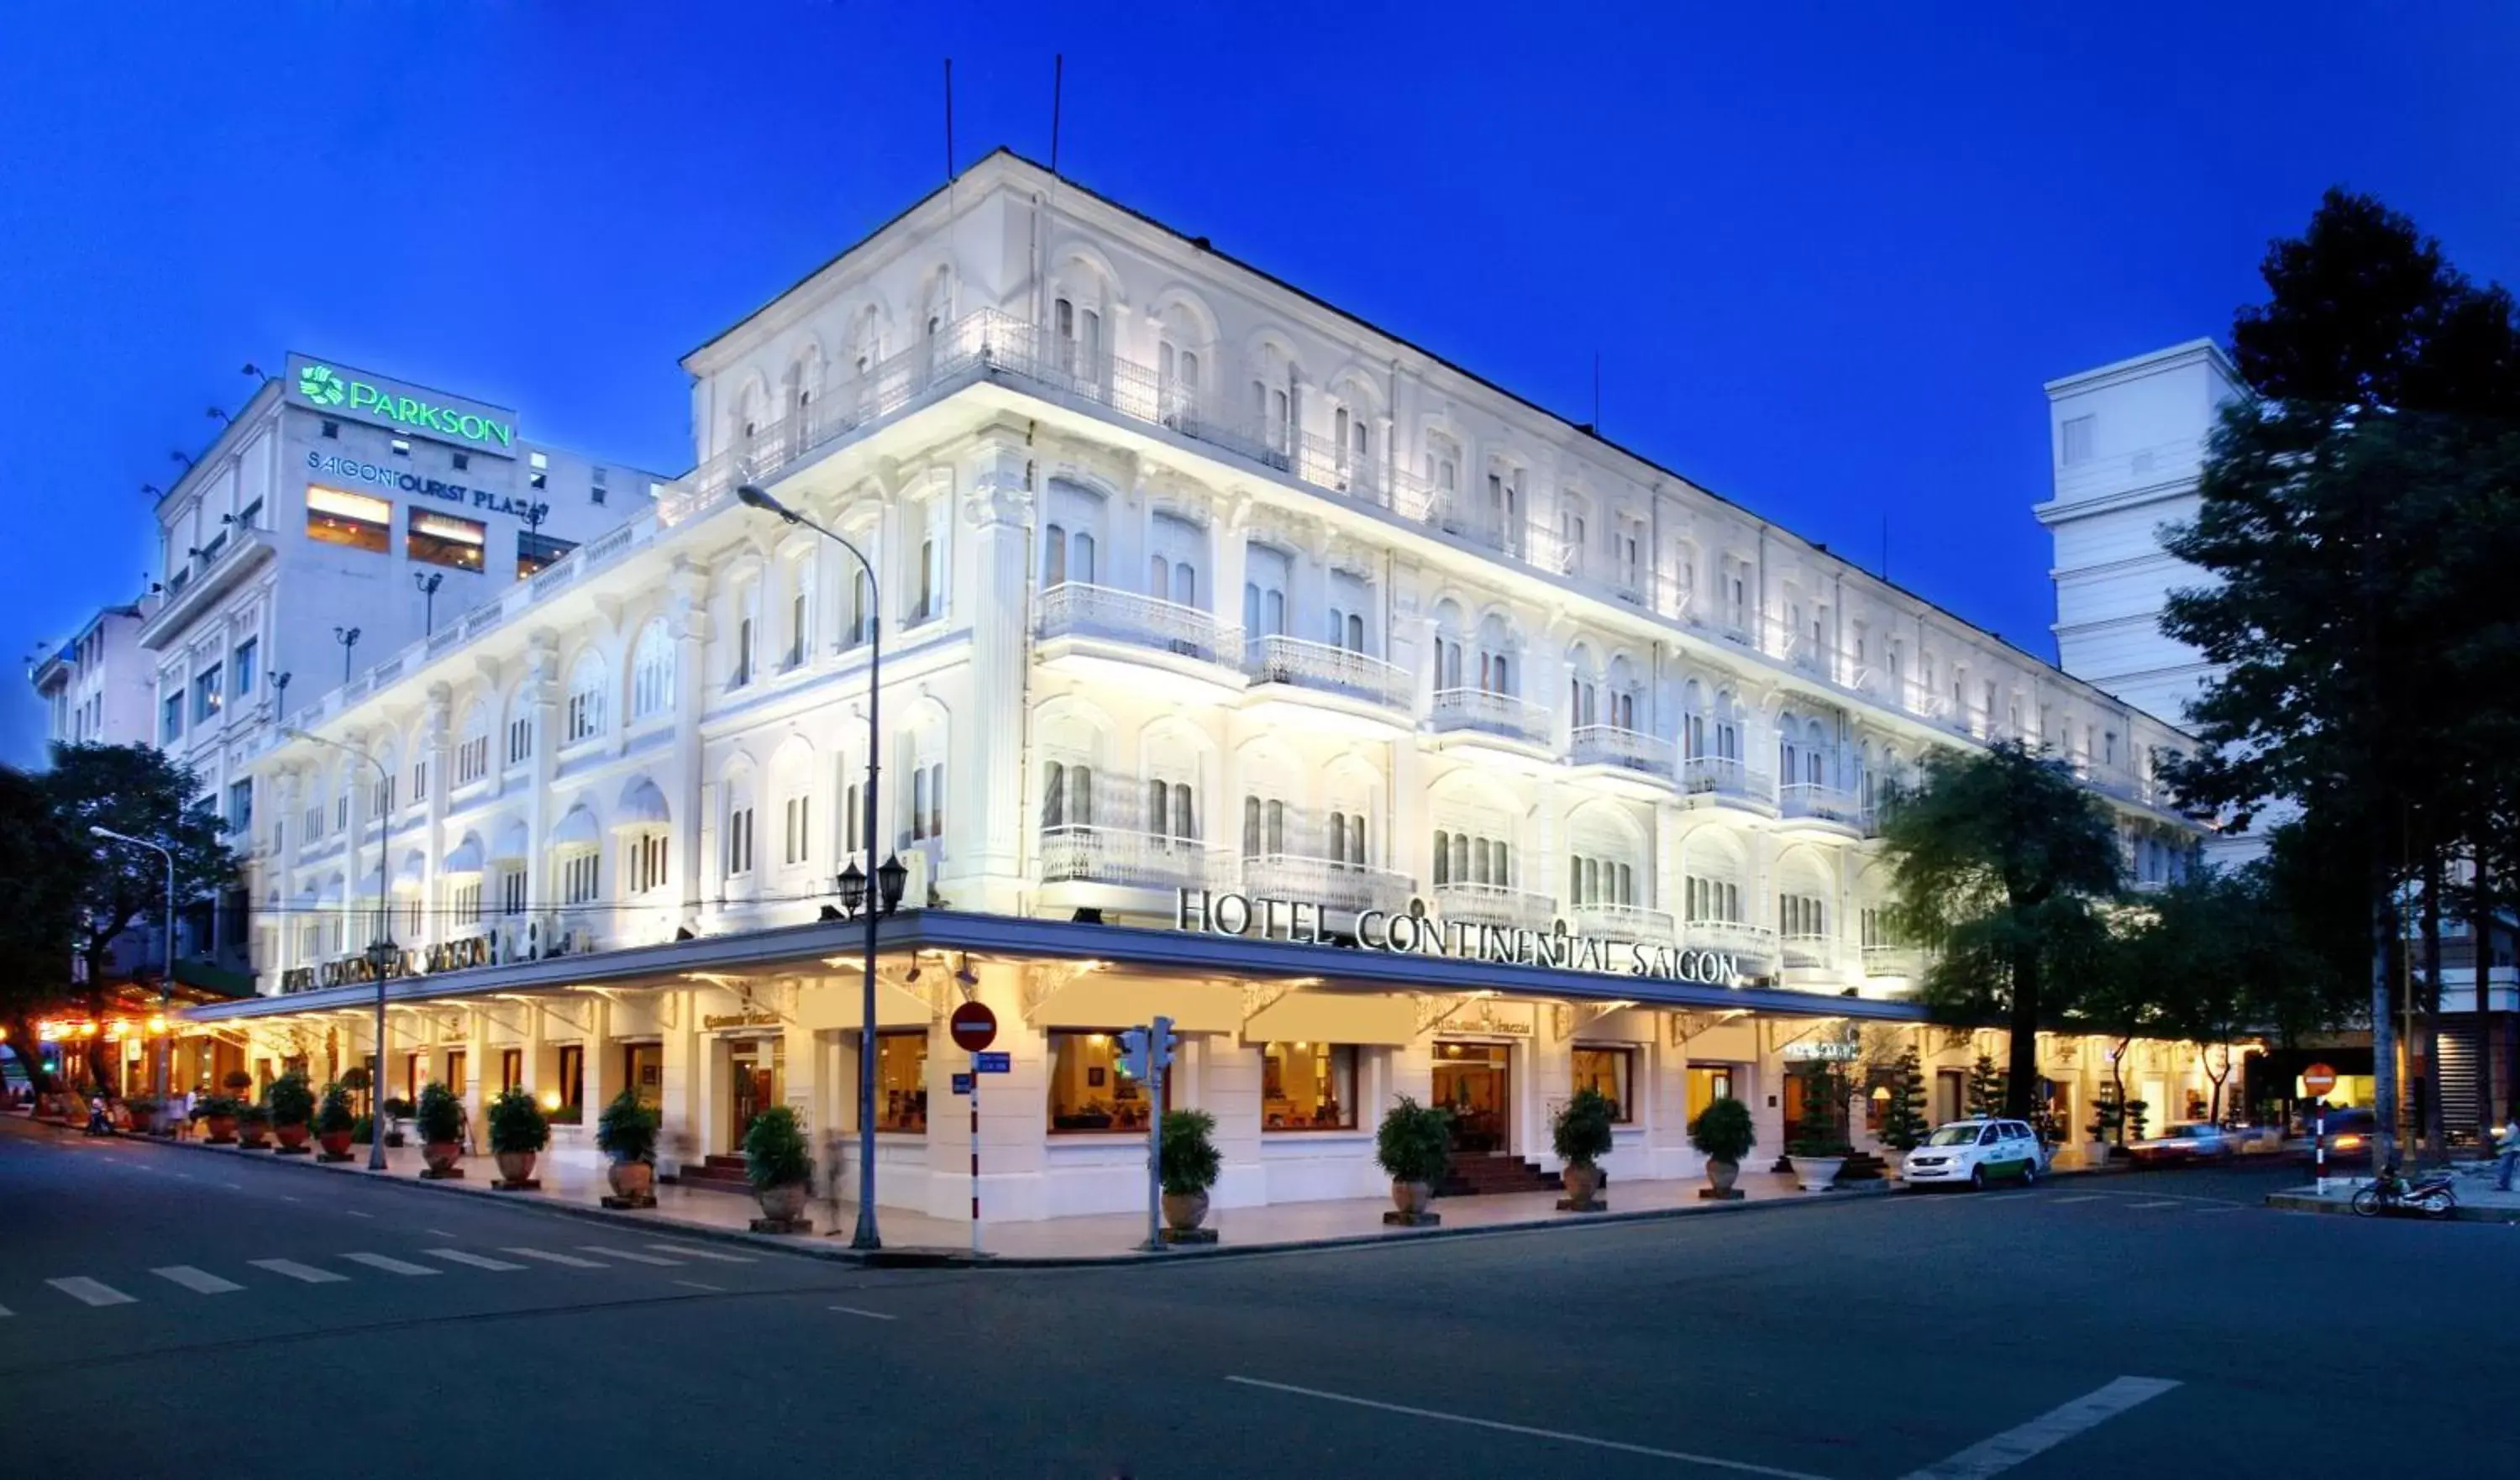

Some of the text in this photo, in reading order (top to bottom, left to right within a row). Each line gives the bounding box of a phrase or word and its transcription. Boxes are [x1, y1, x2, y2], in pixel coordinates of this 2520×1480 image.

[349, 382, 509, 447] PARKSON
[307, 451, 538, 519] SAIGONTOURIST PLAZ
[1176, 886, 1740, 986] HOTEL CONTINENTAL SAIGON
